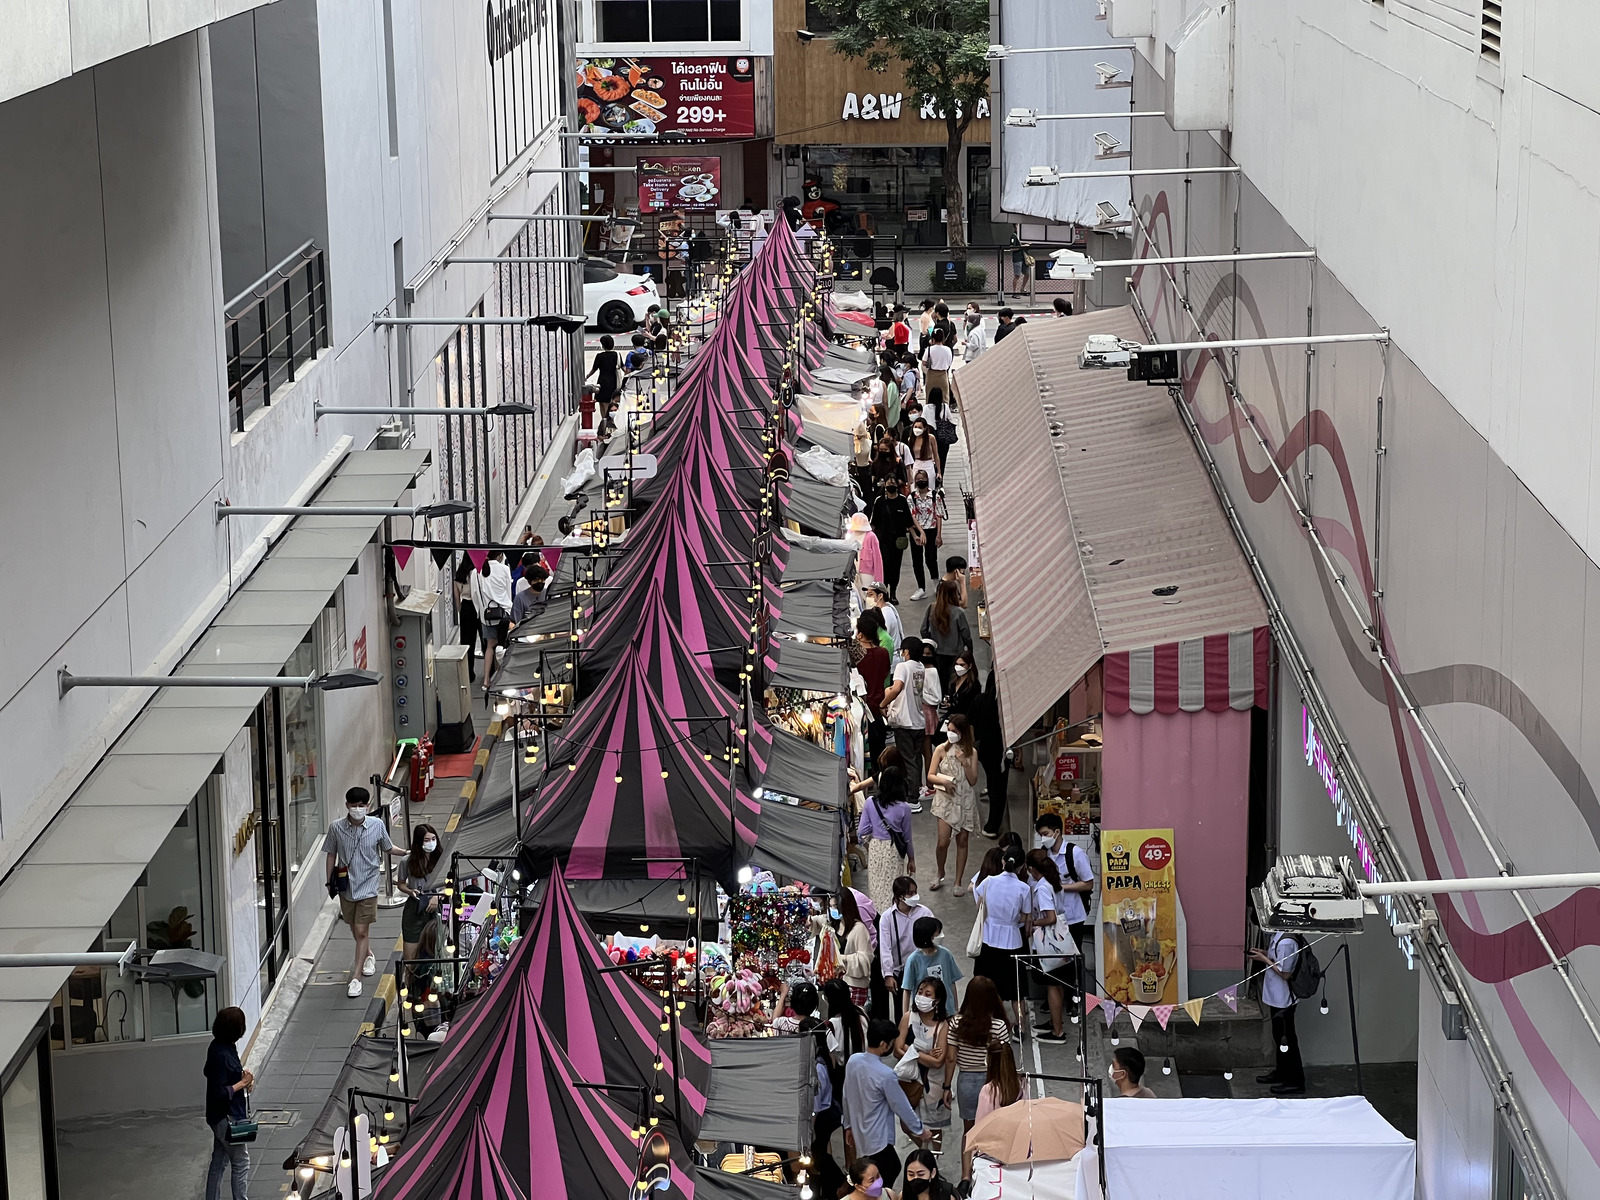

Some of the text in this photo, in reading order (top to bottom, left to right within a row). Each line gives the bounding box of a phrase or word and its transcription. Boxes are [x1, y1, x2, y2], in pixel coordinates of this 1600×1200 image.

[671, 62, 727, 75] ได้เวลาฟิน
[680, 75, 723, 91] กินไม่อั้น
[842, 92, 903, 120] A&W
[676, 105, 727, 124] 299+
[672, 165, 701, 173] Chicken
[1109, 858, 1129, 866] PAPA
[1144, 849, 1171, 861] 49.-
[1106, 875, 1171, 891] PAPA CHEESE
